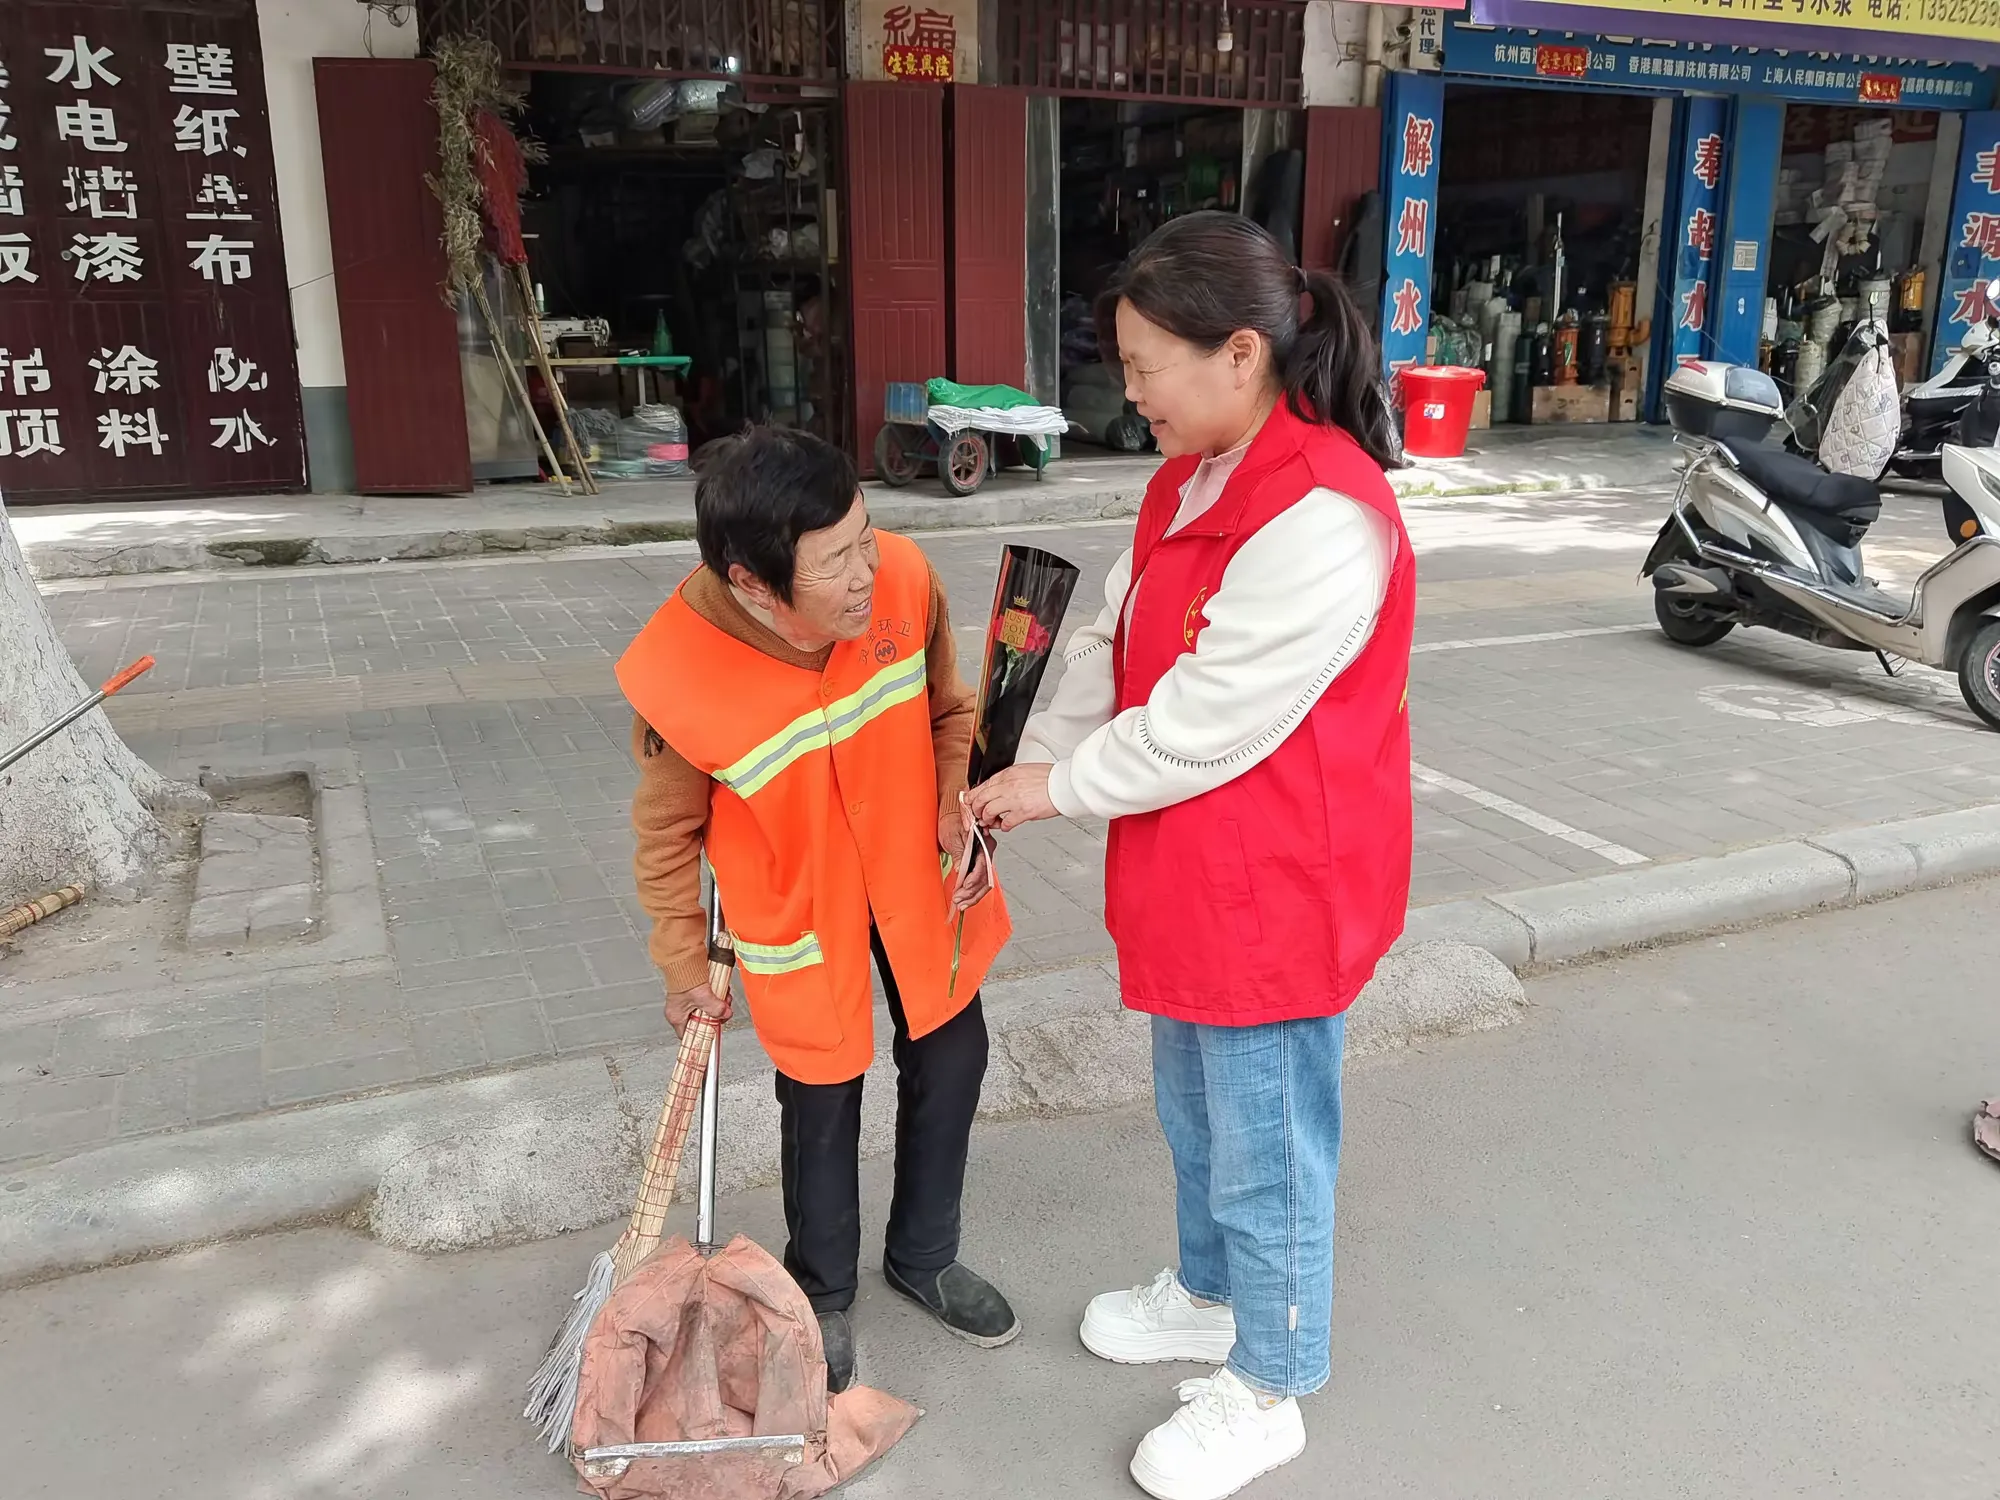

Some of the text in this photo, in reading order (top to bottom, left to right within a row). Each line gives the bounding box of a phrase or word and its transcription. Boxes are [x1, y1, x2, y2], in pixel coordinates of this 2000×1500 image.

[1945, 142, 2000, 369] 丰源水
[88, 344, 170, 458] 涂料
[1001, 632, 1024, 646] YOU
[1003, 621, 1026, 636] FOR
